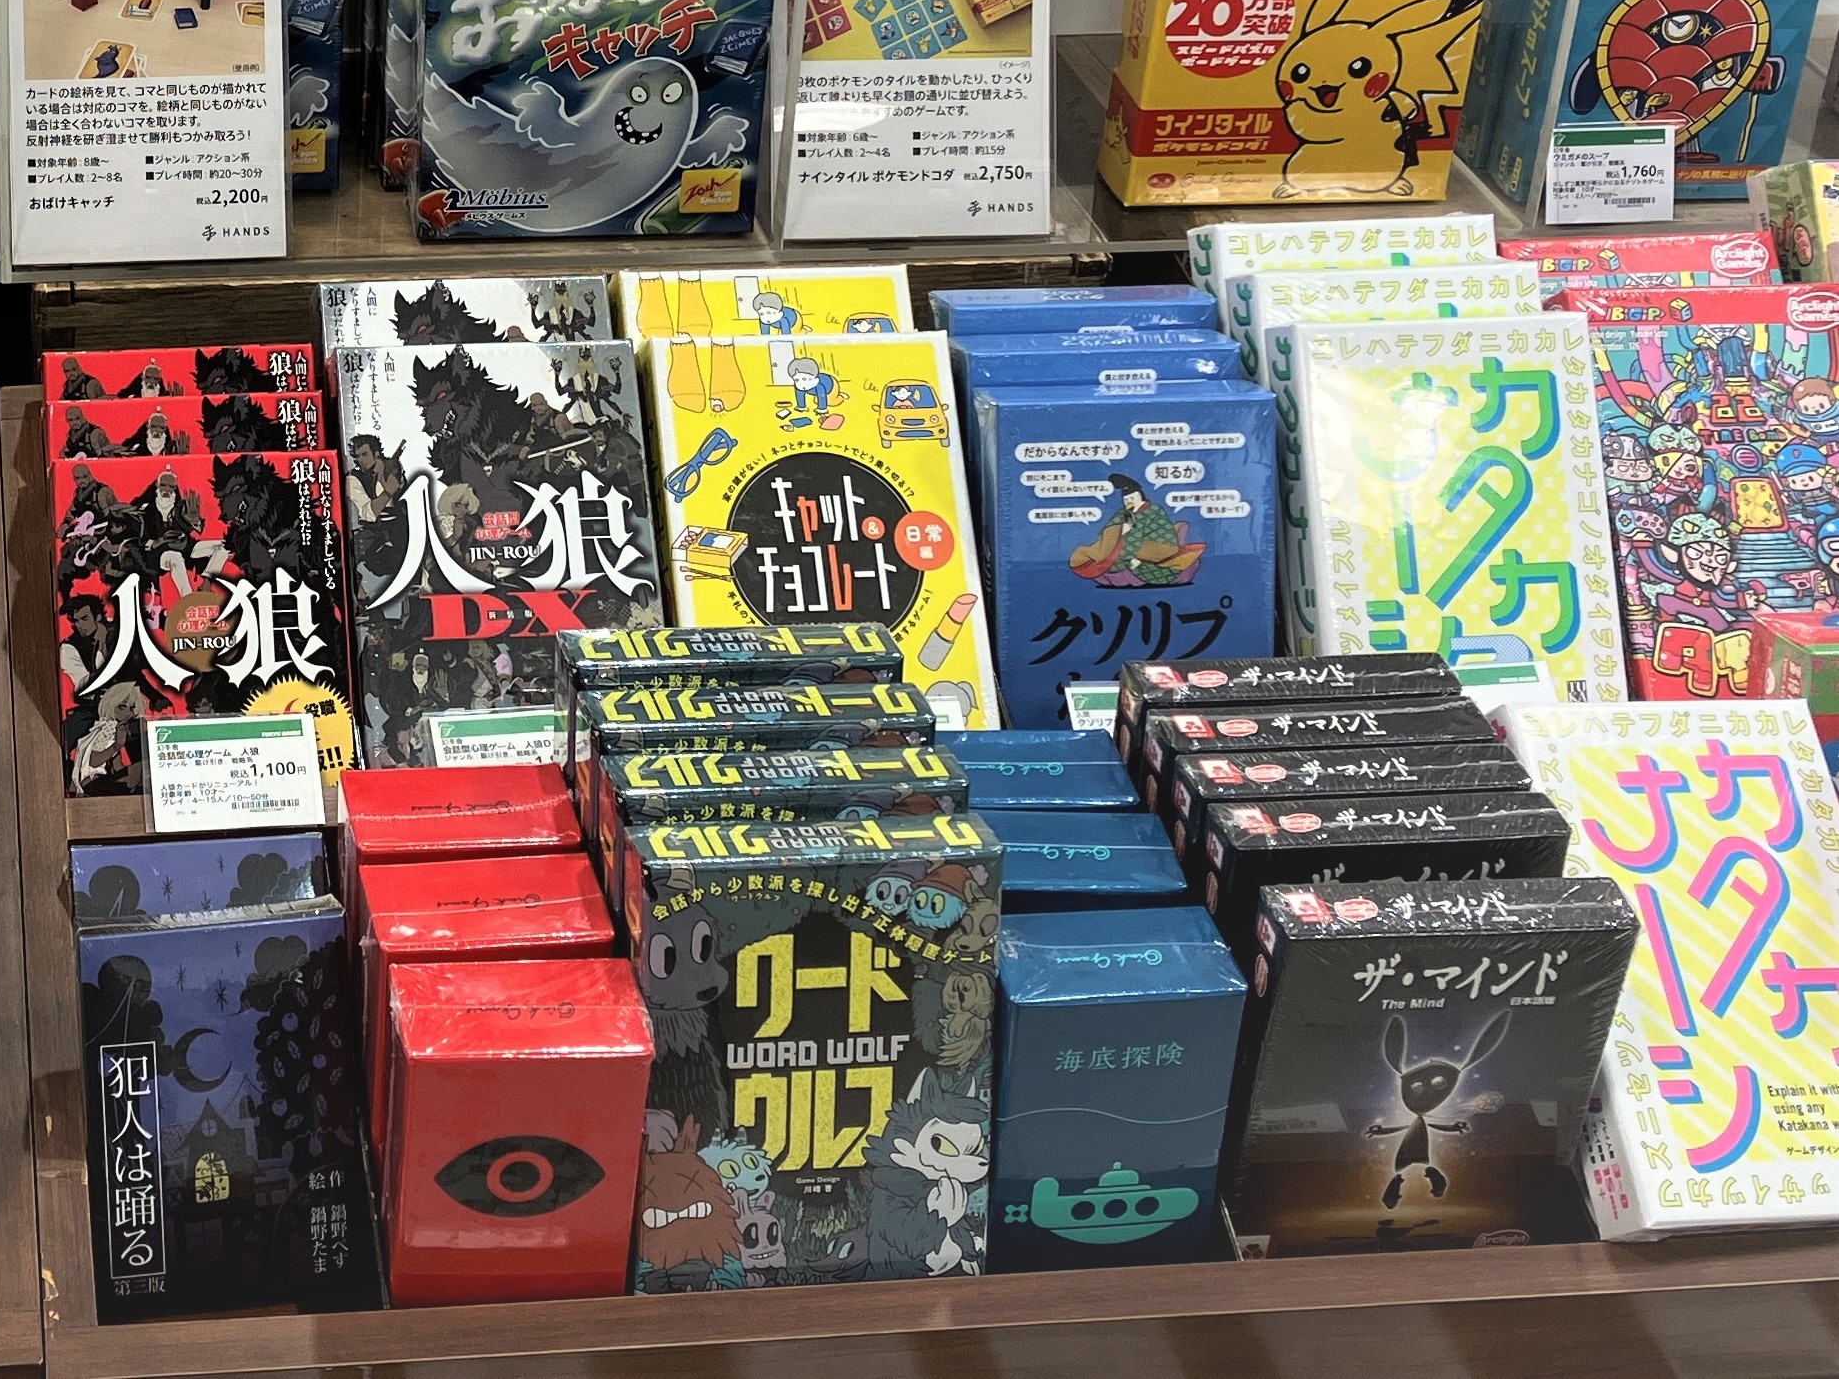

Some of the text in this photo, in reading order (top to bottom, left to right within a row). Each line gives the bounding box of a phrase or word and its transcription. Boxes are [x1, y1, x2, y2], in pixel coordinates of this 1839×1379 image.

[1241, 14, 1293, 36] 突破
[1176, 44, 1276, 55] スピードパズル
[1181, 57, 1266, 67] ボードゲーム
[26, 83, 266, 101] カードの絵柄を見て、コマと同じものが描かれて
[26, 99, 267, 115] いる場合は対応のコマを。絵柄と同じものがない
[26, 115, 202, 130] 場合は全く合わないコマを取ります。
[1155, 113, 1273, 136] ナインタイル
[1554, 152, 1609, 161] ウミガメのスープ
[798, 164, 1032, 183] ナインタイル ポケモンドコダ 税込2,750円
[1606, 165, 1664, 179] 税込1,760円
[29, 189, 268, 210] おばけキャッチ 税込2,200円
[987, 202, 1034, 213] HANDS
[222, 226, 269, 238] HANDS
[1713, 247, 1765, 261] Arclight
[1155, 466, 1197, 479] 知るか
[771, 475, 880, 543] キャット &
[366, 470, 656, 612] 人狼
[470, 544, 541, 561] JIN-ROU
[756, 543, 897, 612] チョコレート
[424, 589, 598, 642] DX
[80, 570, 336, 695] 人狼
[1028, 594, 1234, 667] クソリプ
[172, 635, 237, 652] JIN-ROU
[231, 762, 306, 778] 税込1,100円
[1392, 892, 1510, 919] ザ・マインド
[734, 930, 910, 1039] ワード
[1353, 952, 1568, 1003] ザ・マインド
[1381, 996, 1446, 1010] The Mind
[726, 1034, 910, 1070] WORD WOLF
[1056, 1041, 1186, 1073] 海底探険
[1768, 1083, 1818, 1099] Explain it
[1774, 1103, 1826, 1117] using any
[732, 1065, 893, 1174] ウルフ
[1778, 1118, 1829, 1132] Katakana
[109, 1054, 156, 1267] 犯人は踊る
